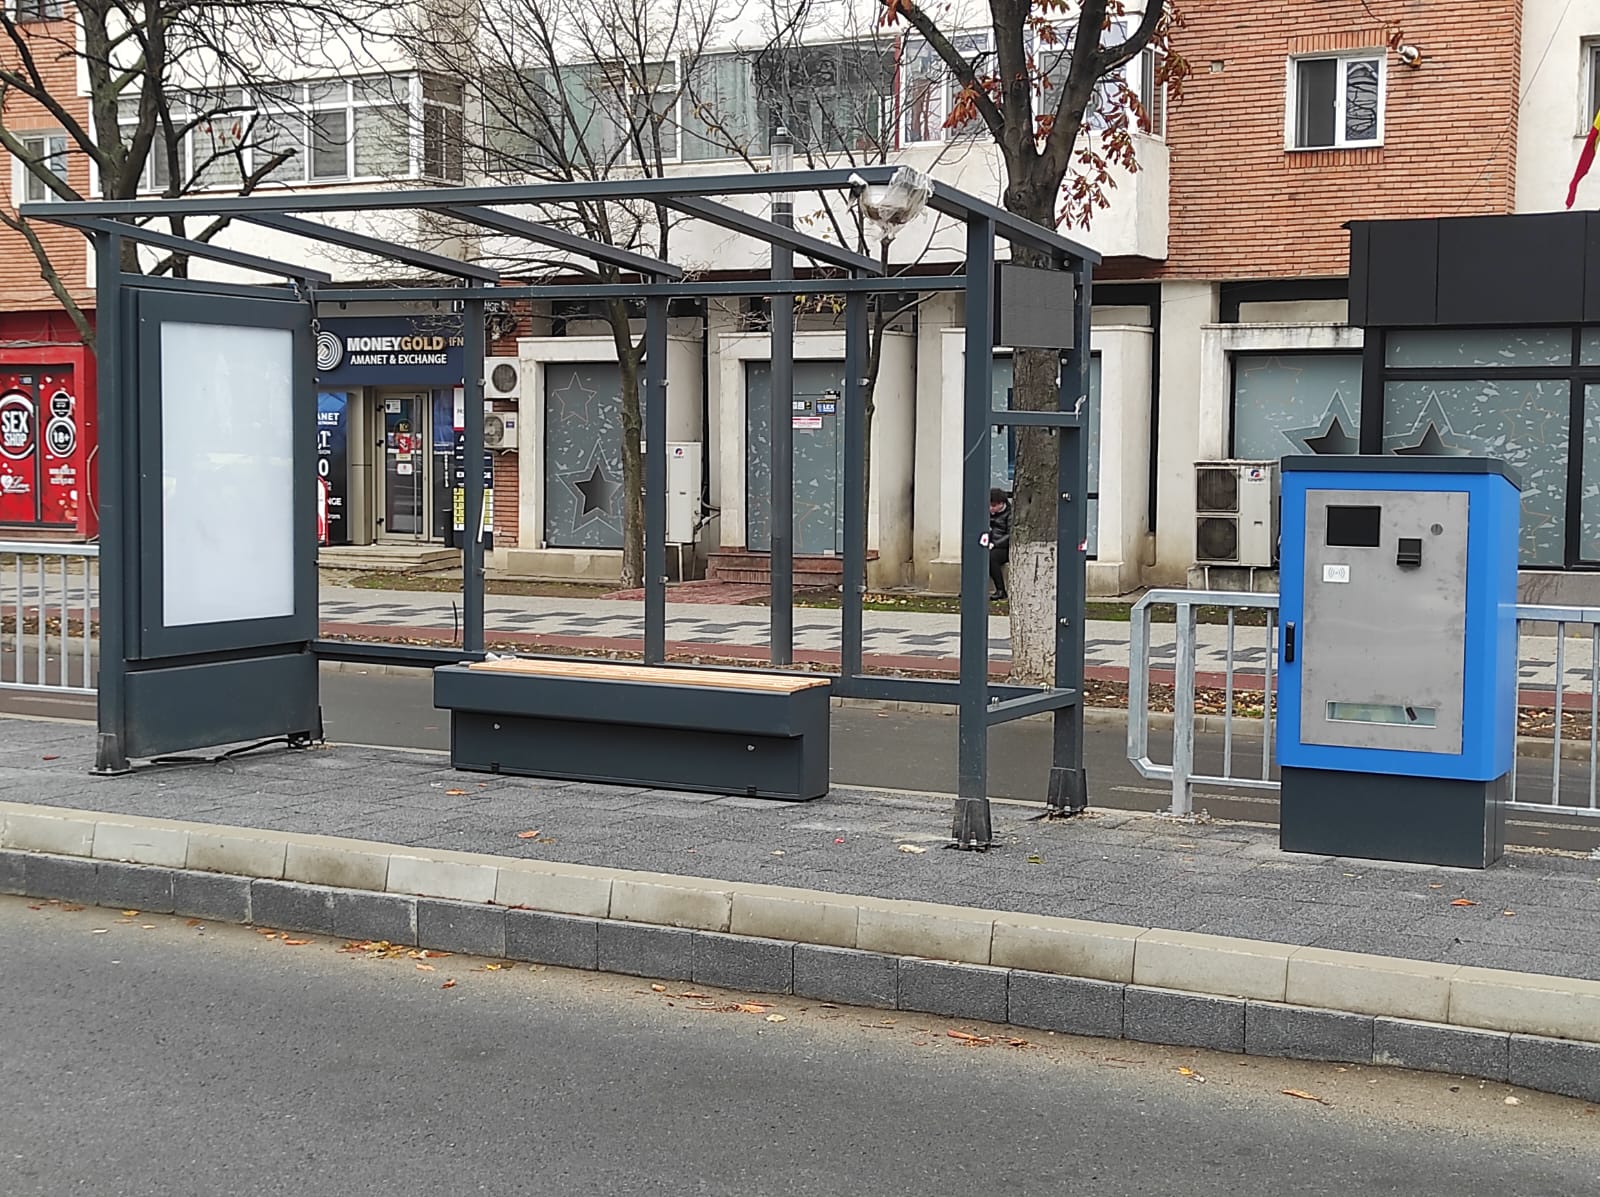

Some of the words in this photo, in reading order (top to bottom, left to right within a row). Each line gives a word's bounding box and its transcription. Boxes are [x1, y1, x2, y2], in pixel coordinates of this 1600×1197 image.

[347, 337, 444, 352] MONEYGOLD
[350, 355, 388, 365] AMANET
[390, 355, 396, 364] &
[399, 354, 447, 364] EXCHANGE
[1, 410, 29, 433] SEX
[3, 433, 27, 447] SHOP
[53, 431, 70, 443] 18+
